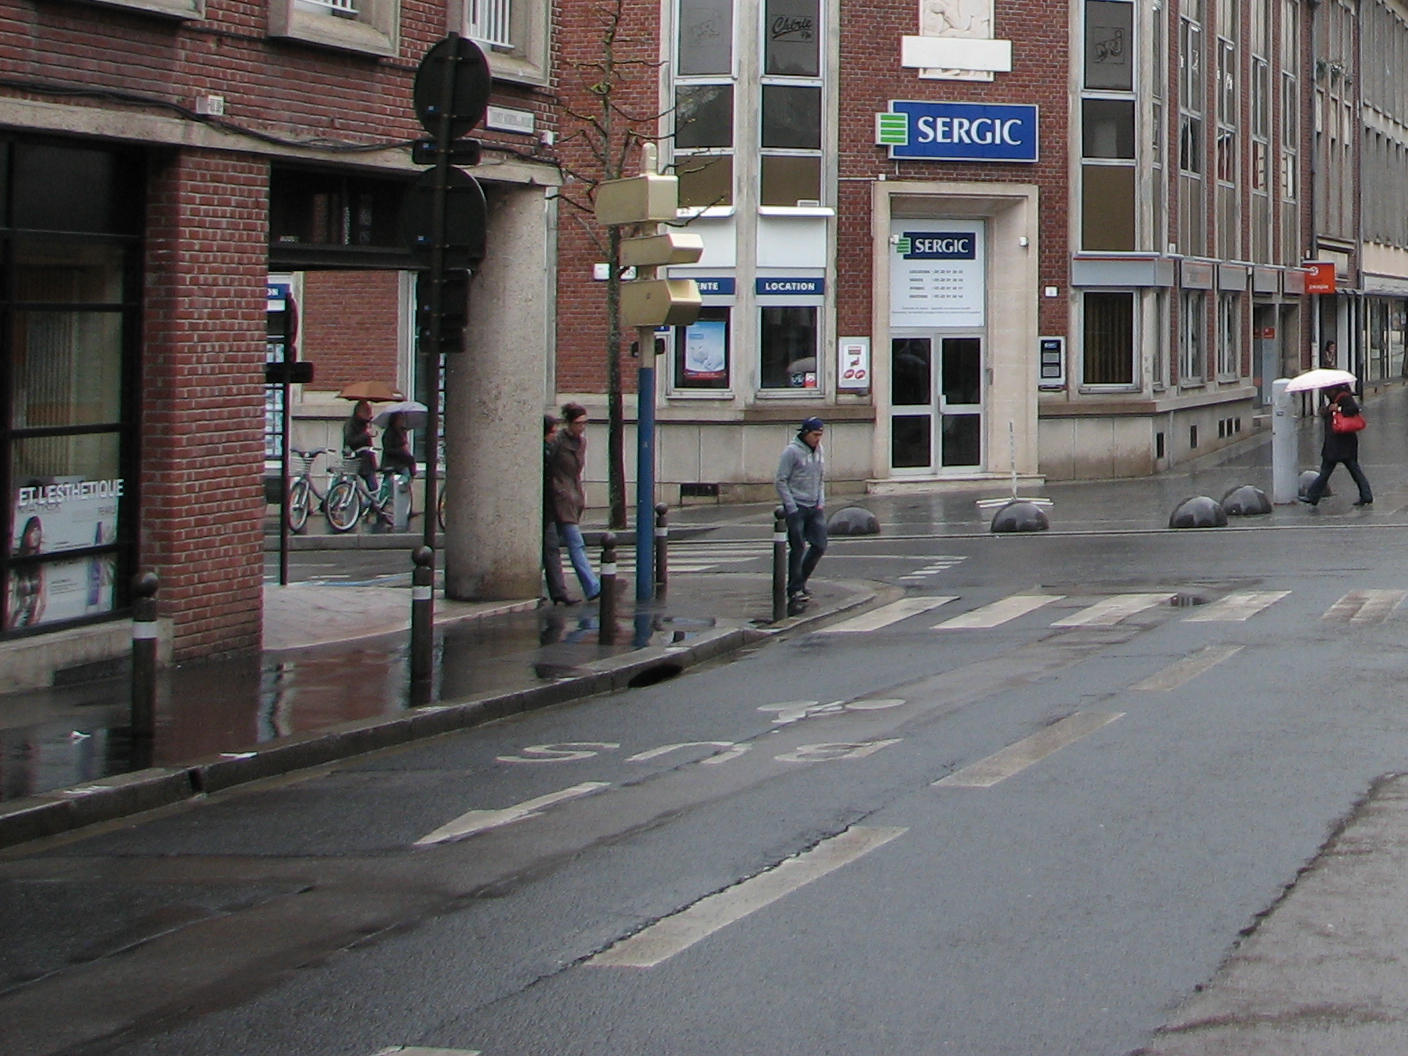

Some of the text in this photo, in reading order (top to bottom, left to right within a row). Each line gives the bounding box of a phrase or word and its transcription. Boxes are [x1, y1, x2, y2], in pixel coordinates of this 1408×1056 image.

[917, 116, 1022, 145] SERGIC
[915, 238, 969, 254] SERGIC
[765, 282, 815, 291] LOCATION
[18, 486, 37, 507] ET
